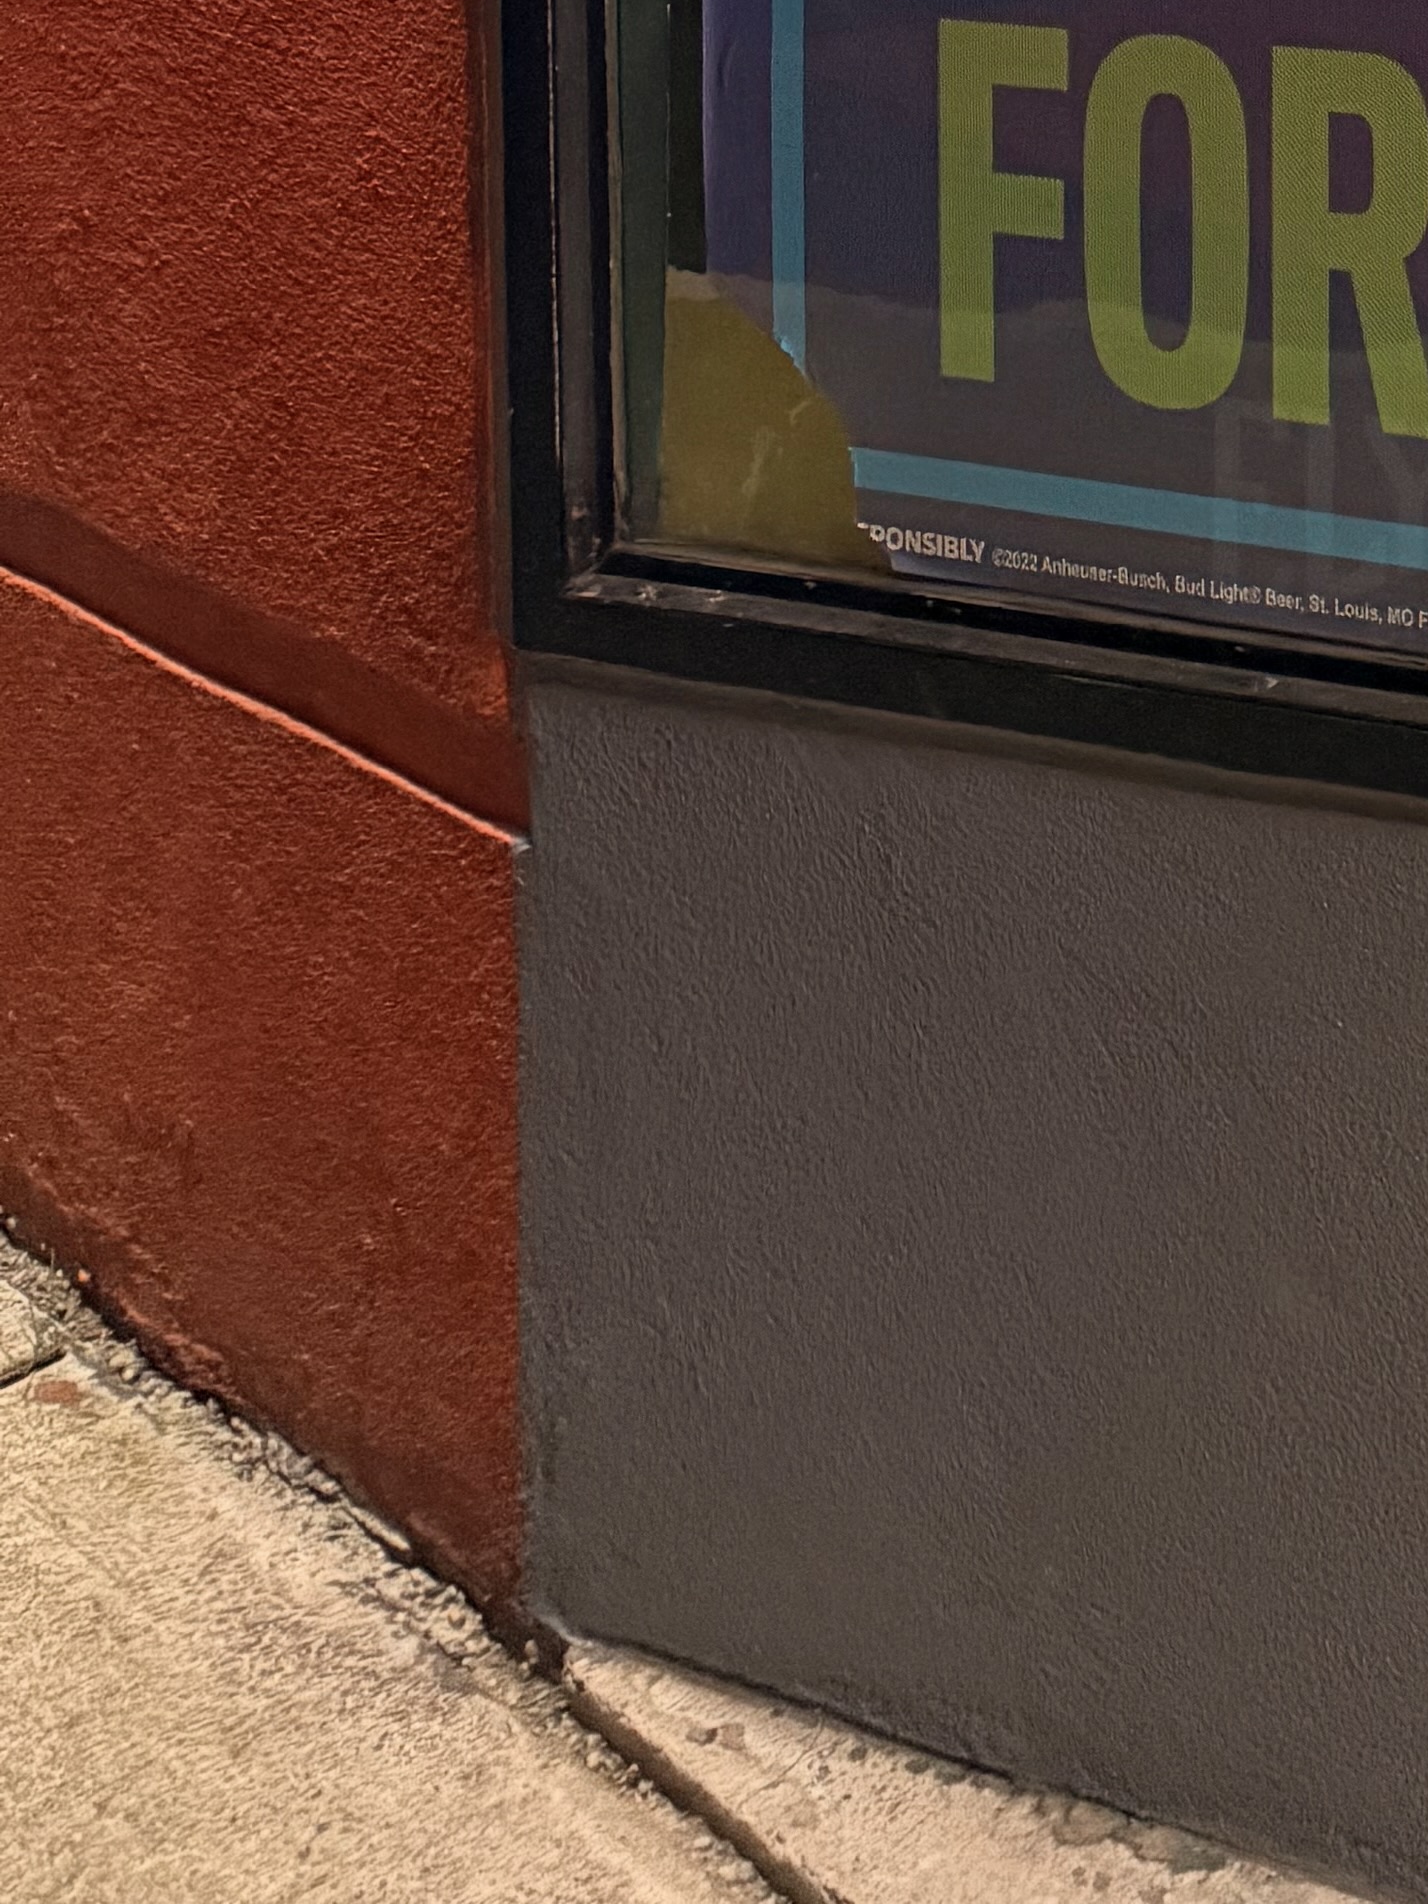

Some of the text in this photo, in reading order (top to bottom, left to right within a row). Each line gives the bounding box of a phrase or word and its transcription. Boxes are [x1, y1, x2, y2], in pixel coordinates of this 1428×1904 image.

[857, 521, 985, 564] PONSIBLY
[1175, 575, 1206, 598] Bud
[1335, 598, 1383, 625] Louis,
[1387, 606, 1414, 628] MO
